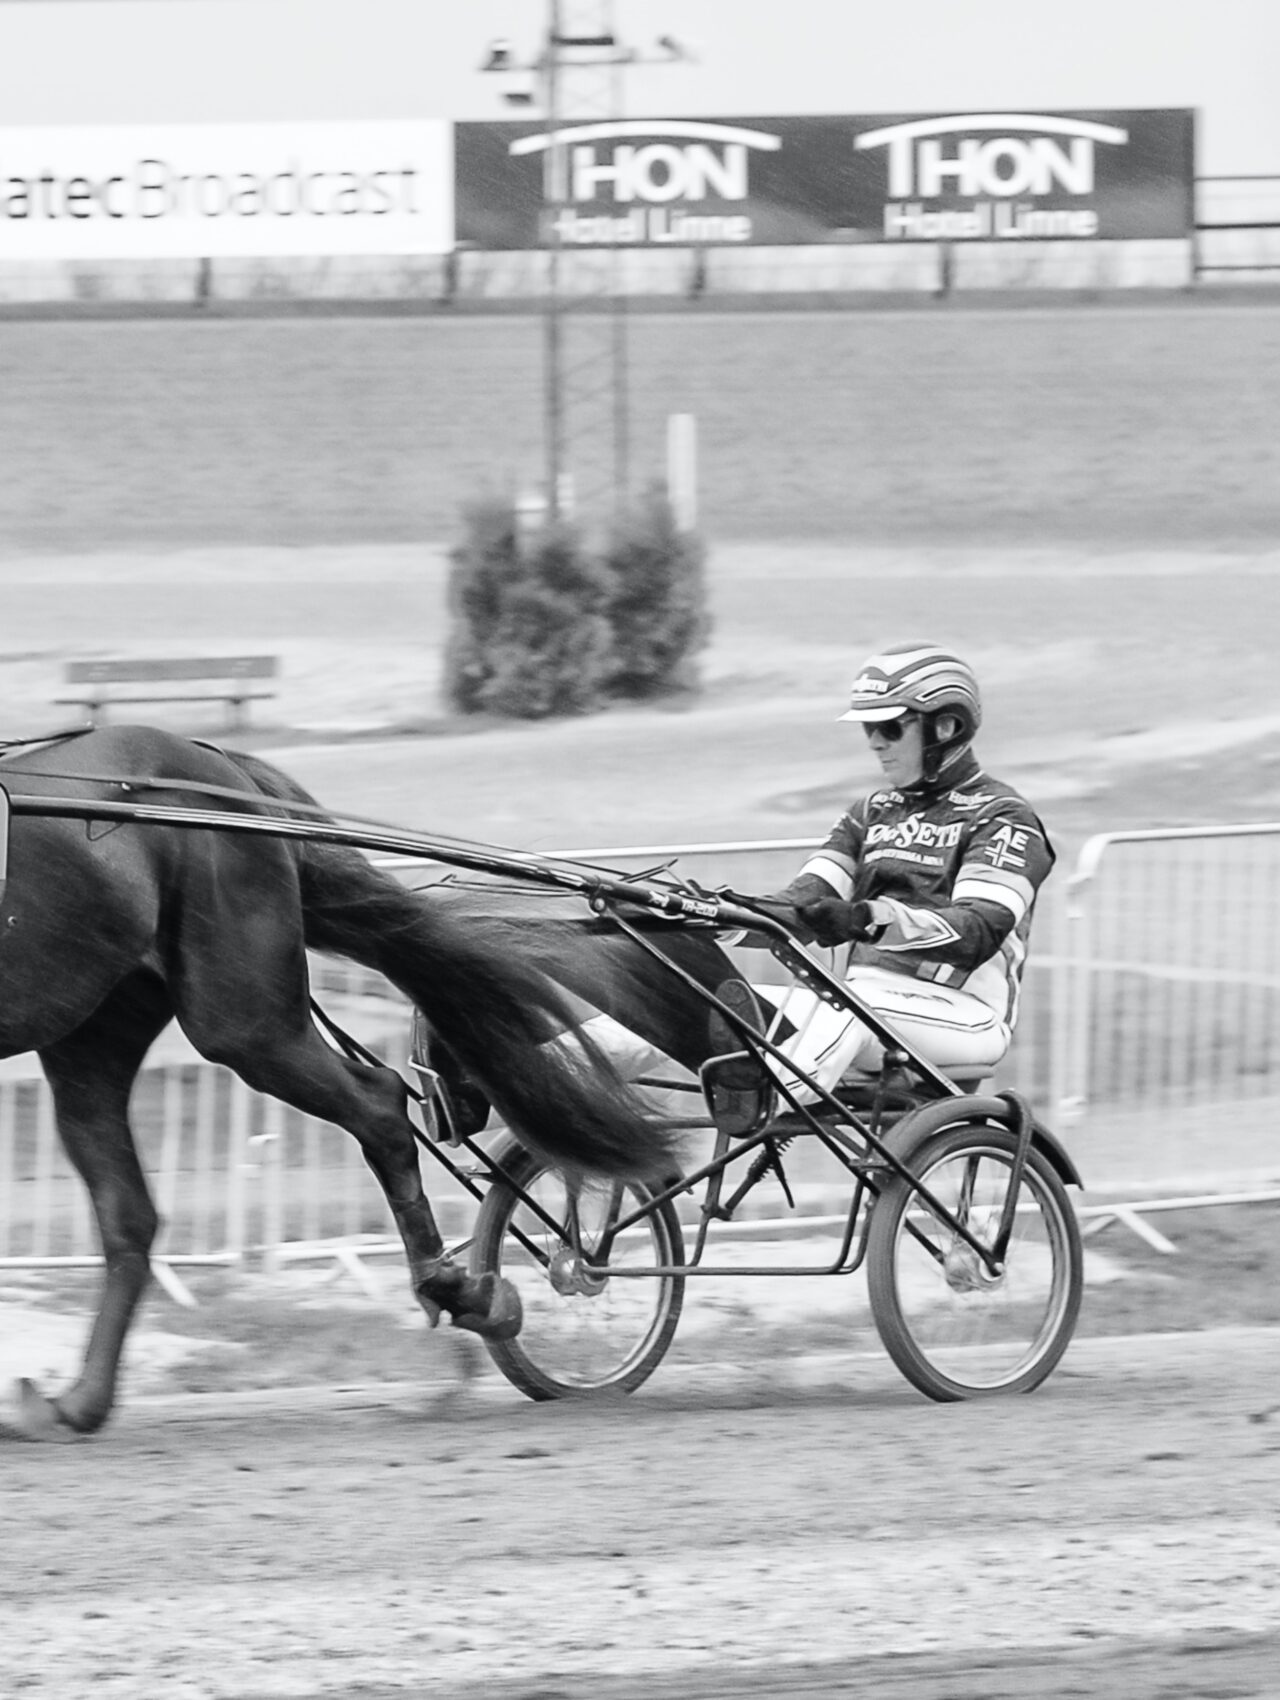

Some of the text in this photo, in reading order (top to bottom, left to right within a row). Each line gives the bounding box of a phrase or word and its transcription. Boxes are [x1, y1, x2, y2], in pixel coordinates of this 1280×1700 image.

[509, 120, 782, 202] THON
[855, 113, 1128, 198] THON
[883, 202, 991, 238] Hotel
[990, 825, 1029, 851] AE
